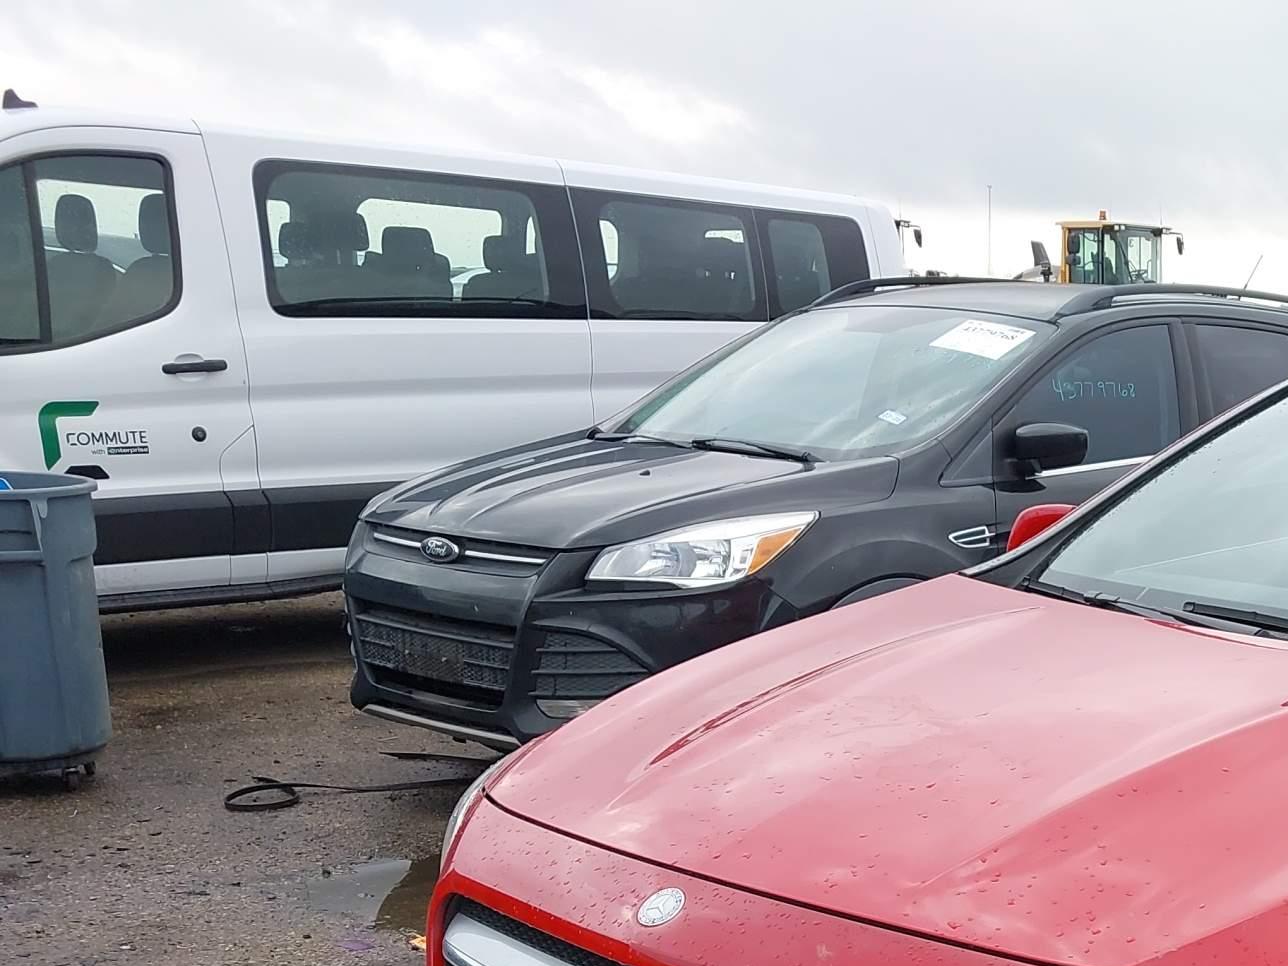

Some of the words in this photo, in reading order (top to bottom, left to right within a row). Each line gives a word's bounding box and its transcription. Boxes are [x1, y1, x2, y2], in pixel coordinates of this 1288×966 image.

[1052, 379, 1136, 401] 43779768
[66, 430, 148, 446] COMMUTE
[425, 540, 447, 556] Ford
